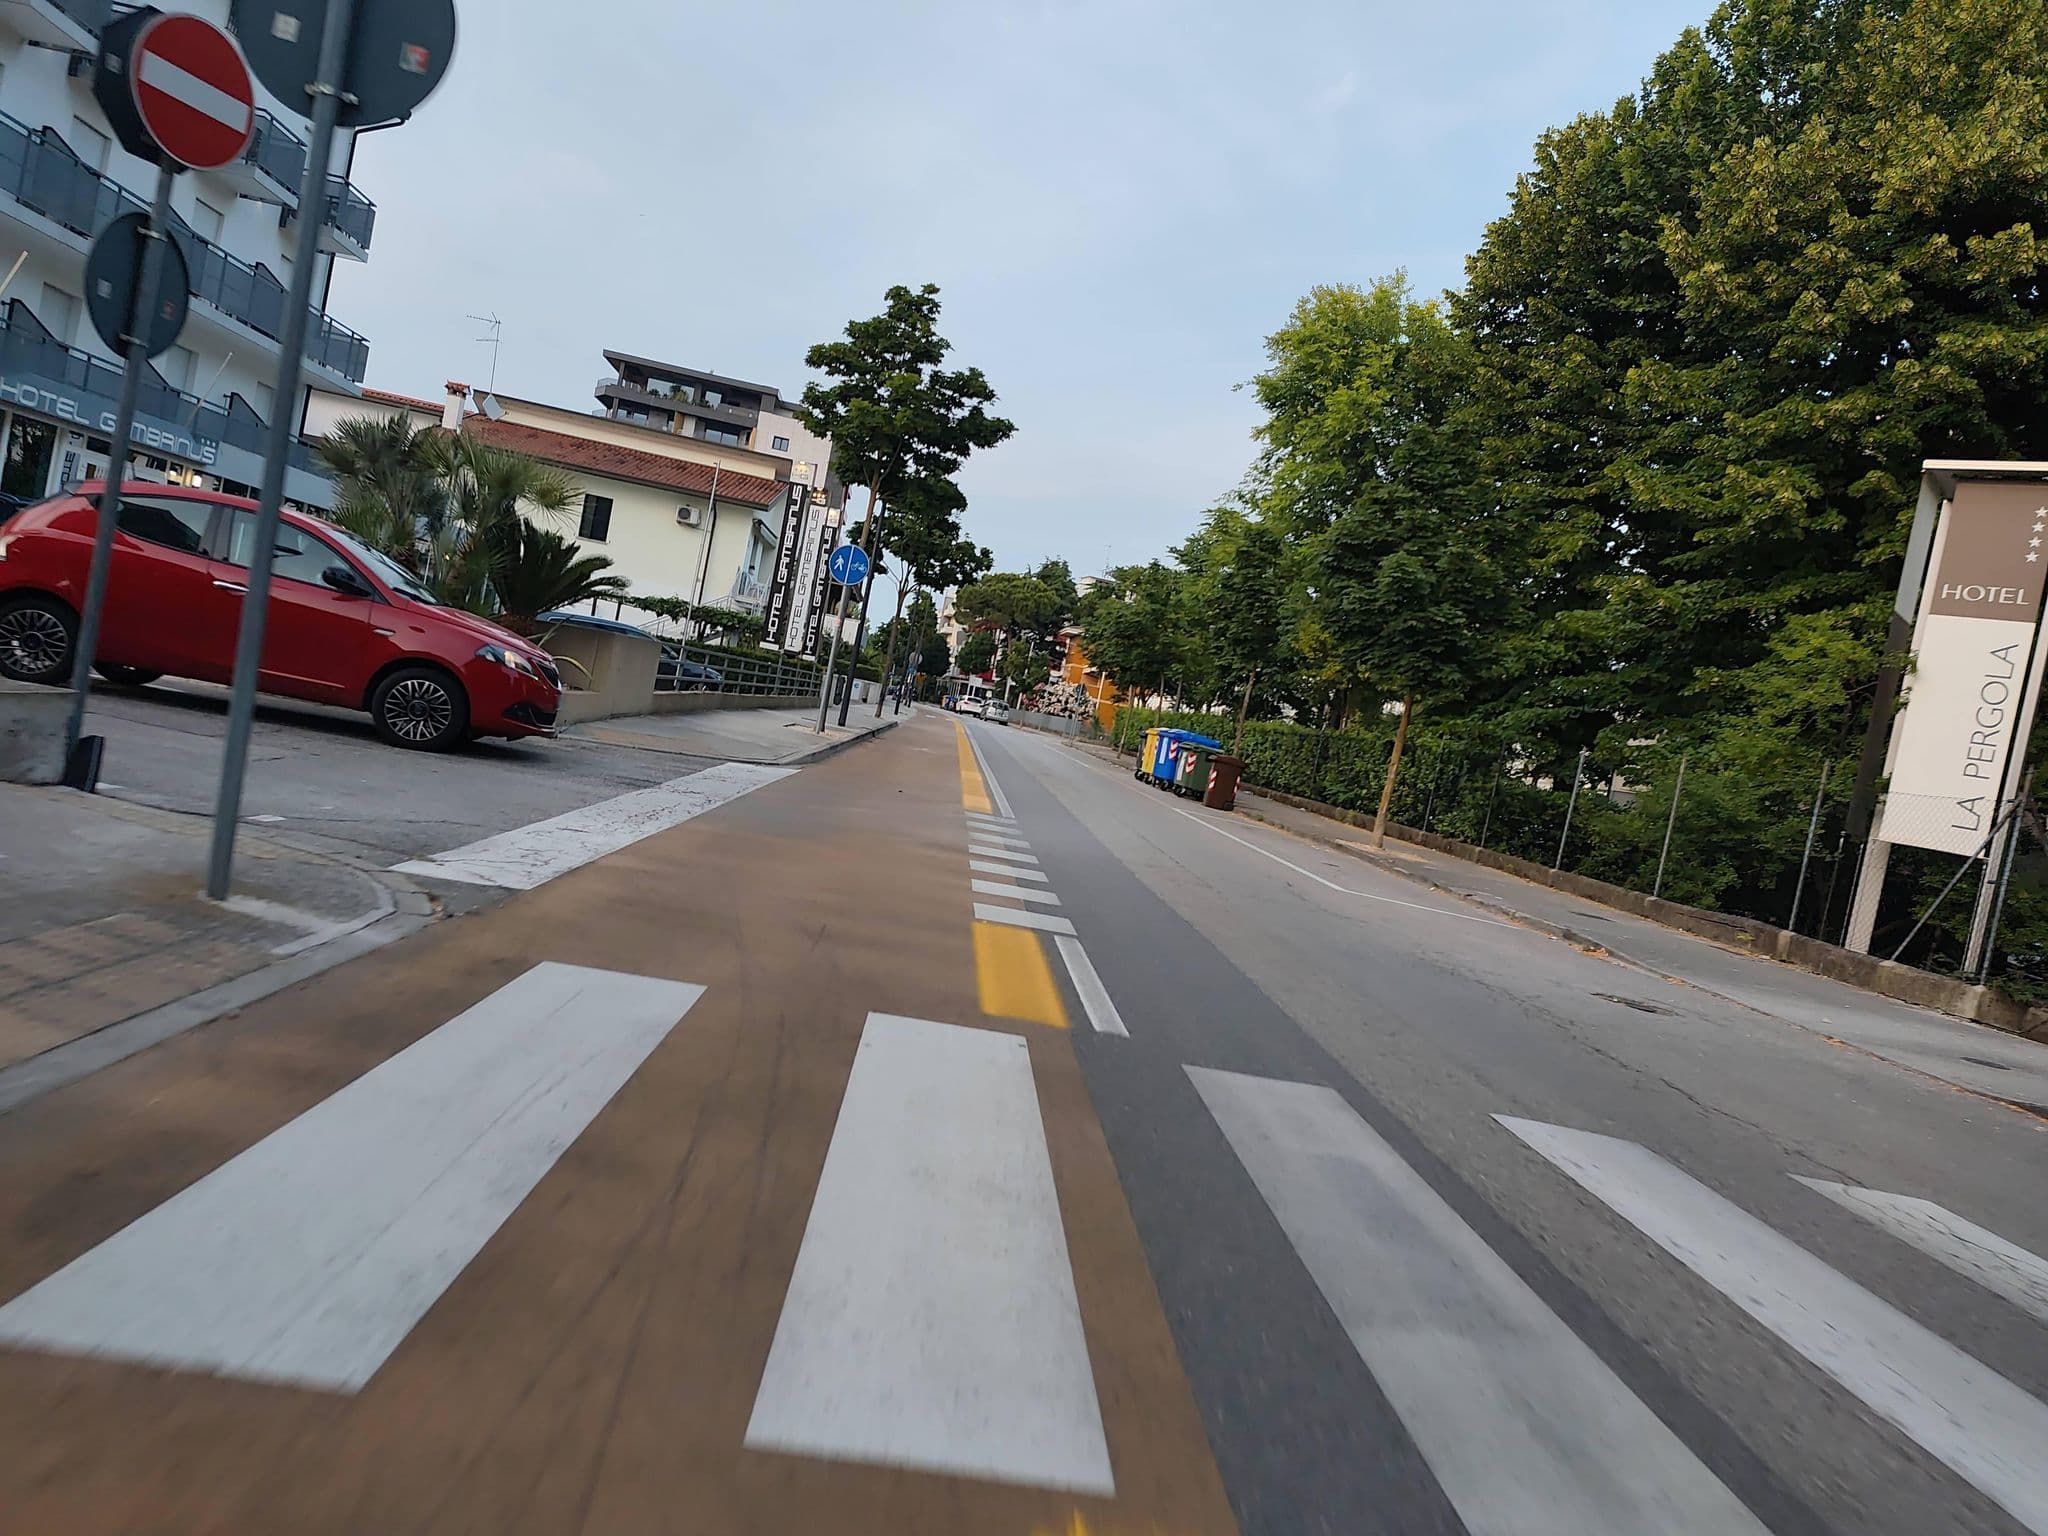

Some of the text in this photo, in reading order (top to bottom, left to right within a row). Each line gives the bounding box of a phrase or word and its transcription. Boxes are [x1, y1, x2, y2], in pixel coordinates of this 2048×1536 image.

[0, 377, 217, 466] HOTEL GMBRINUS
[766, 587, 785, 642] HOTEL
[777, 484, 803, 584] GAMBRINUS
[788, 598, 804, 648] HOTEL
[797, 508, 820, 596] GAMBRINUS
[805, 608, 820, 654] HOTEL
[813, 527, 834, 607] GAMBRINUS
[1941, 583, 2030, 606] HOTEL
[1951, 643, 2020, 832] LA PERGOLA
